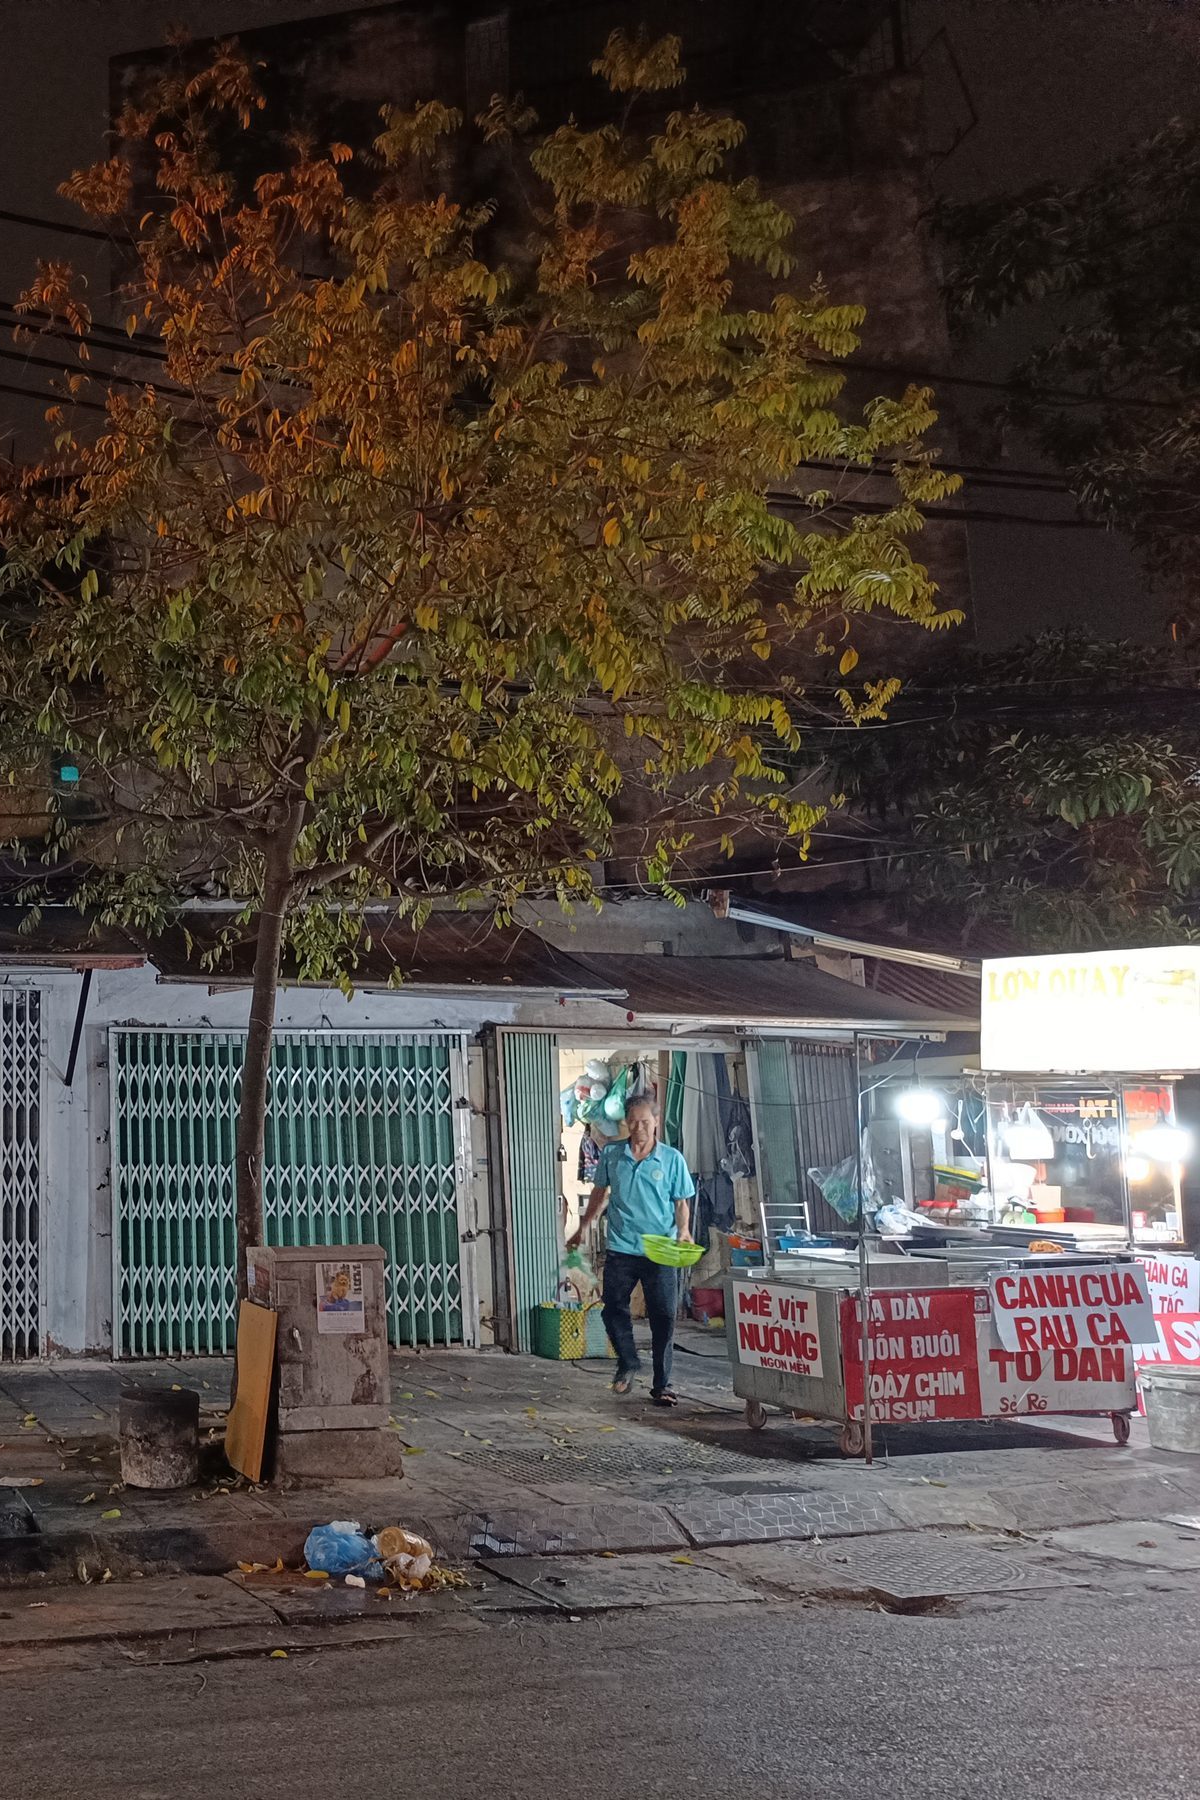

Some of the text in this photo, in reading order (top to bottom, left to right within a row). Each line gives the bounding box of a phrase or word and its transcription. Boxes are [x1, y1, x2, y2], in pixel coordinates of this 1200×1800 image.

[1172, 1262, 1188, 1288] GÀ
[739, 1285, 772, 1317] MỀ
[890, 1293, 931, 1320] DÀY
[739, 1319, 818, 1361] NƯỚNG
[1014, 1307, 1131, 1351] RAU CÀ
[911, 1329, 960, 1358] ĐUÔI
[760, 1356, 788, 1370] NGON
[892, 1400, 936, 1422] SỤN
